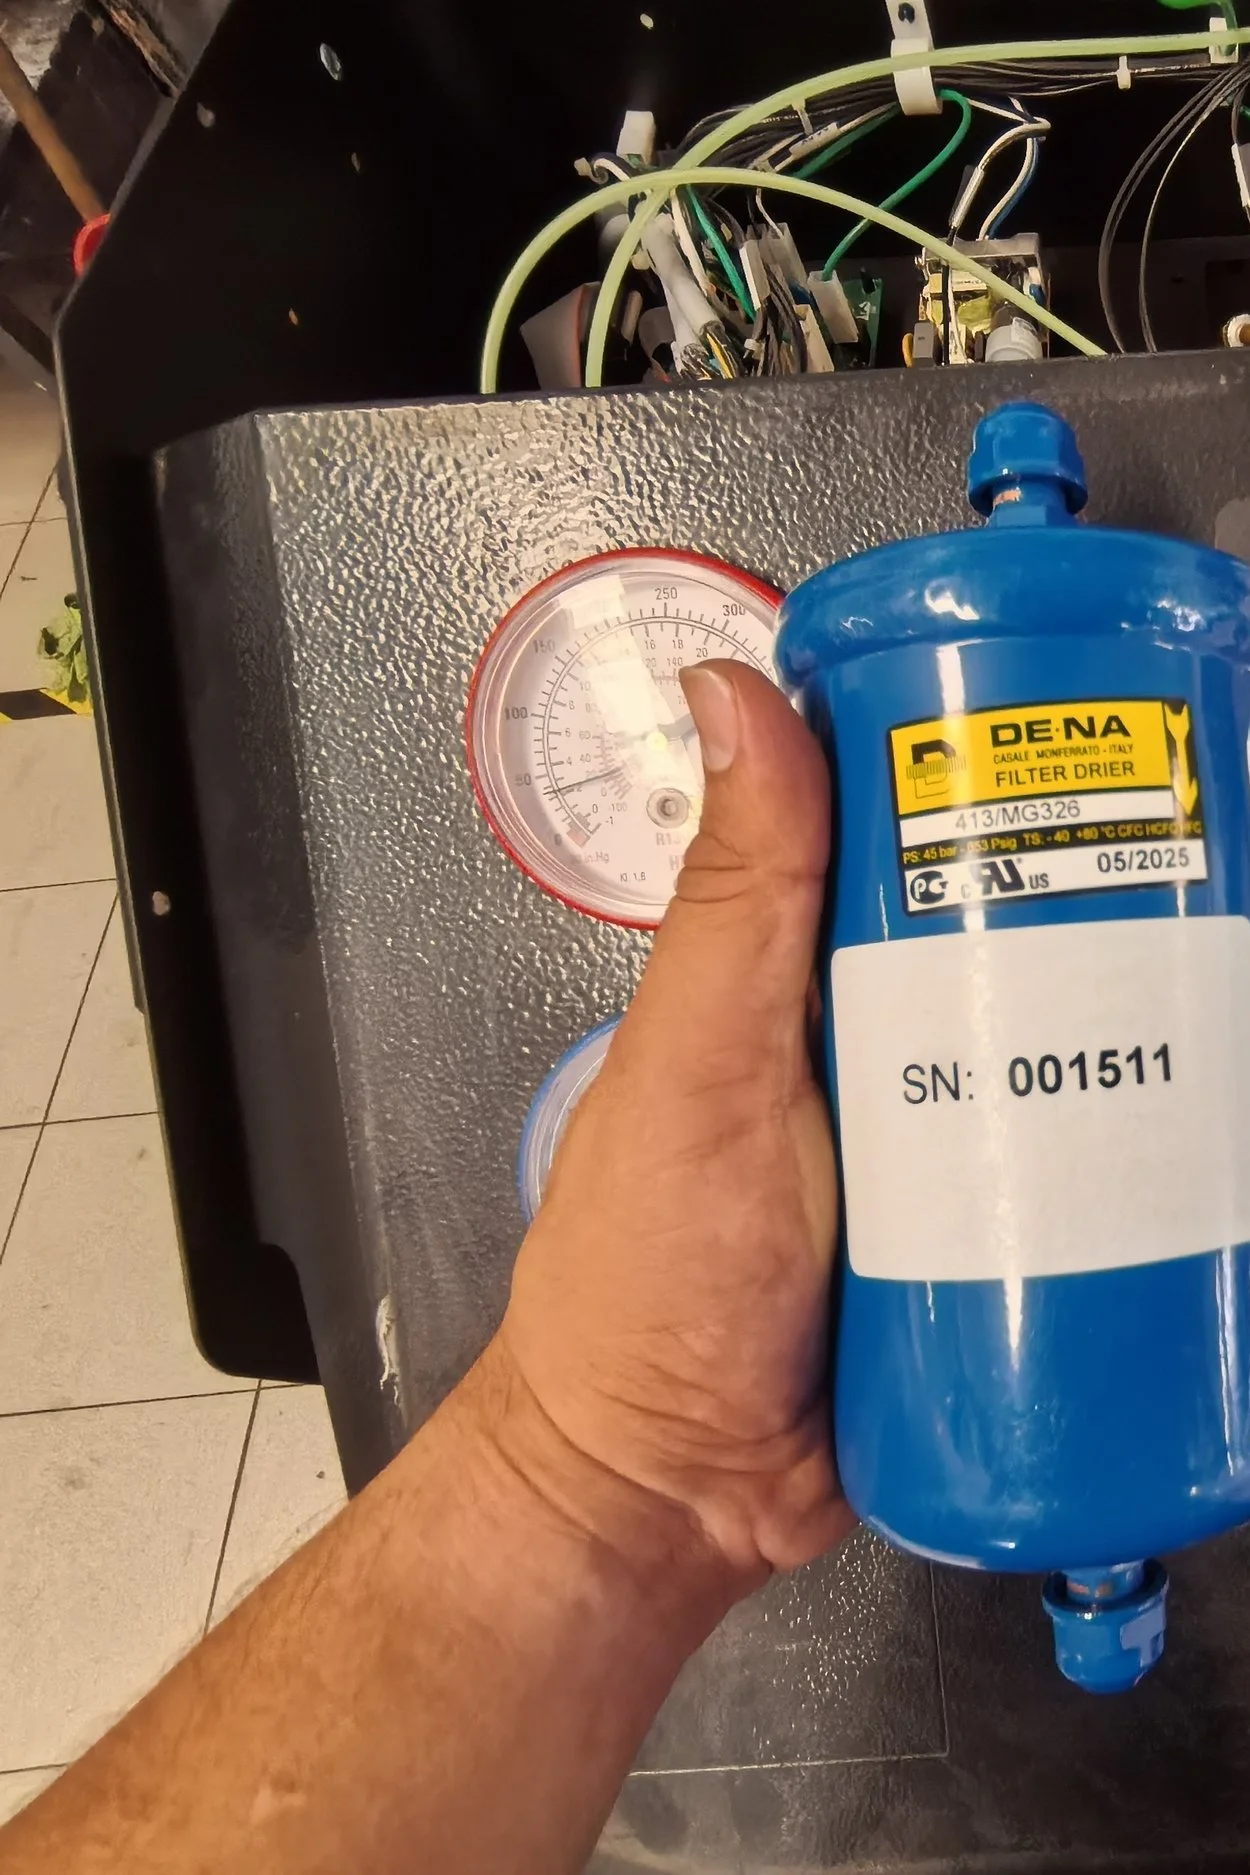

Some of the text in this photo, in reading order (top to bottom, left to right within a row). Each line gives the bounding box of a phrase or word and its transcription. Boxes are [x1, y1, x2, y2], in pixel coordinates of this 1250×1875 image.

[655, 587, 678, 600] 250
[722, 604, 746, 617] 300
[696, 647, 708, 658] 20
[504, 707, 528, 720] 100
[993, 751, 1029, 764] CASALE
[1109, 744, 1134, 754] ITALY
[995, 761, 1135, 788] FILTER DRIER
[592, 804, 598, 814] 0
[955, 799, 1081, 831] 413/MG326
[923, 847, 937, 860] 45
[1097, 847, 1190, 873] 05/2025
[902, 1043, 1173, 1105] SN: 001511
